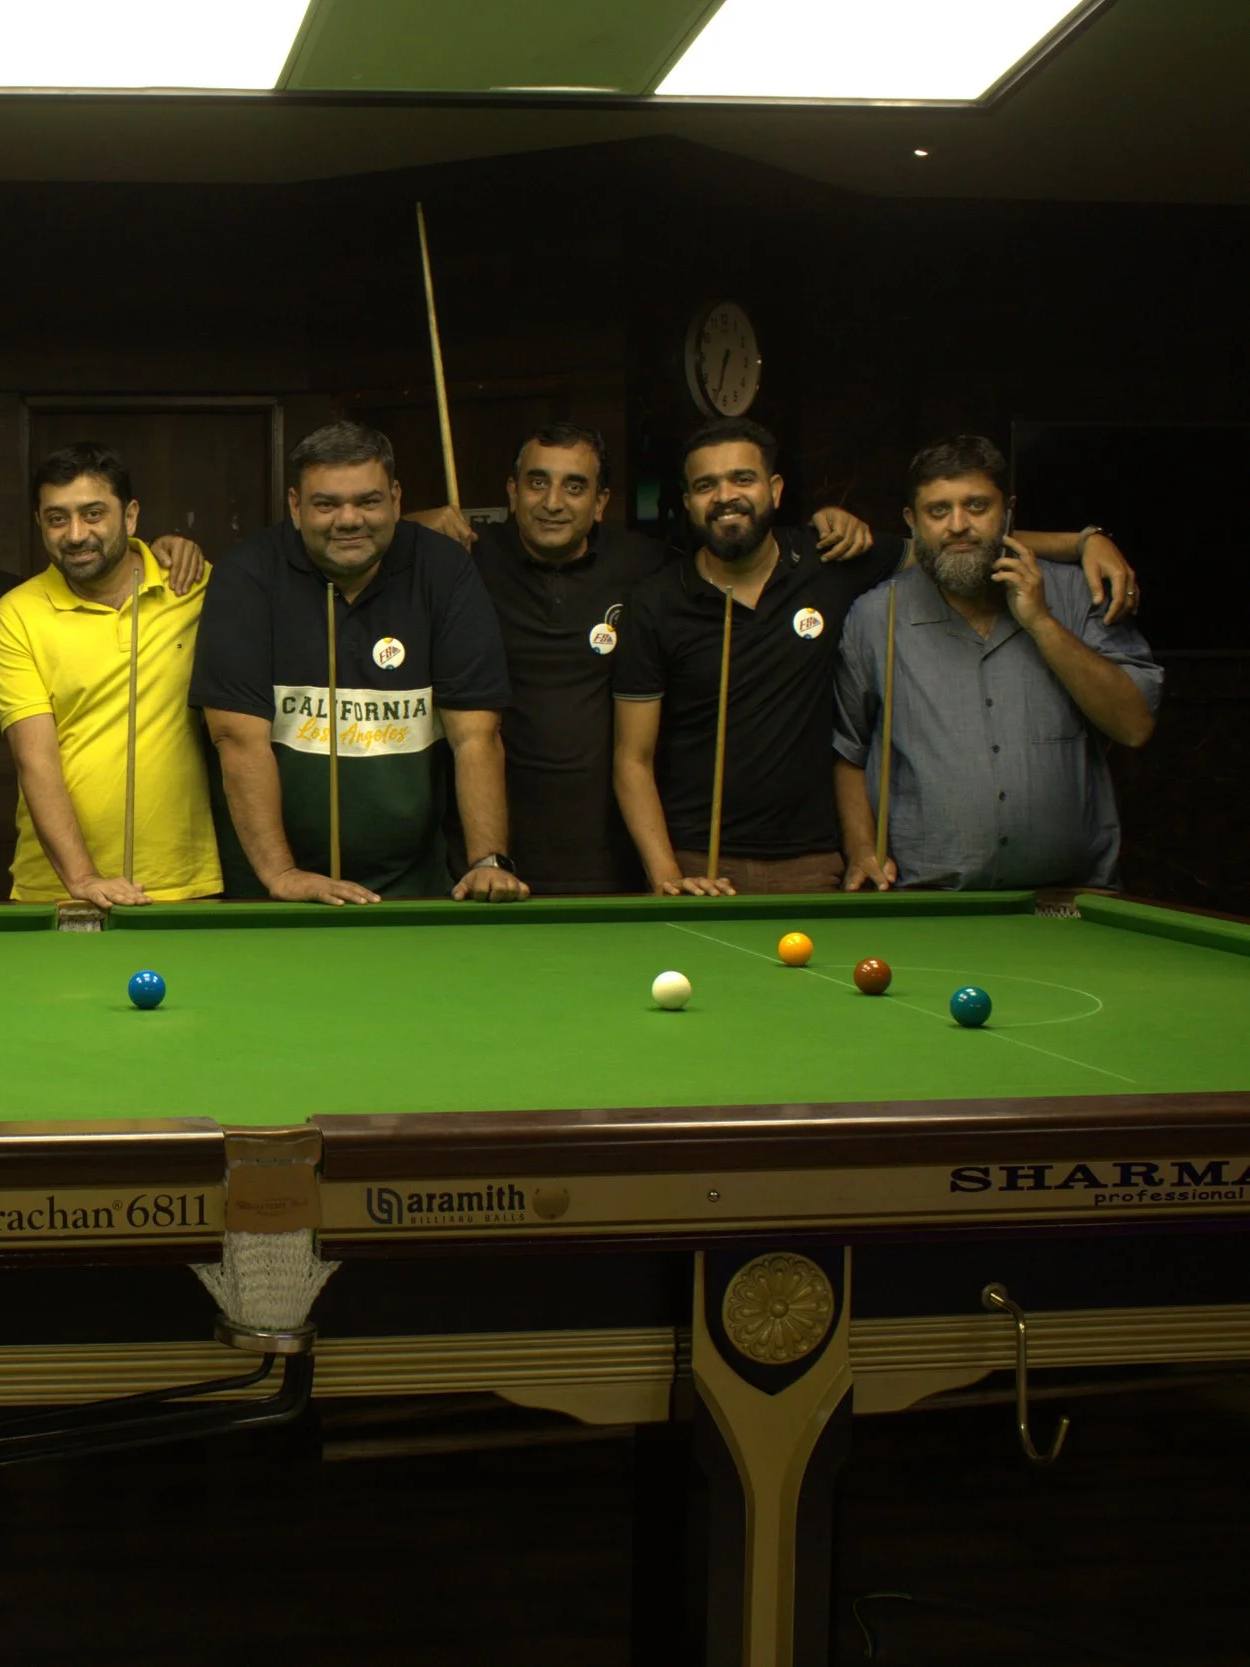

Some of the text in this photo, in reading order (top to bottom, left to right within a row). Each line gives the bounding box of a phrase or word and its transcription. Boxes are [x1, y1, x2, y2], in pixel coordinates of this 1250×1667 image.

[282, 696, 427, 722] CALFORNIA
[296, 717, 409, 749] Los Angeles
[407, 1184, 526, 1213] aramith
[1094, 1186, 1245, 1206] professional
[126, 1193, 210, 1228] 6811
[410, 1213, 526, 1224] BILLIARD BALLS
